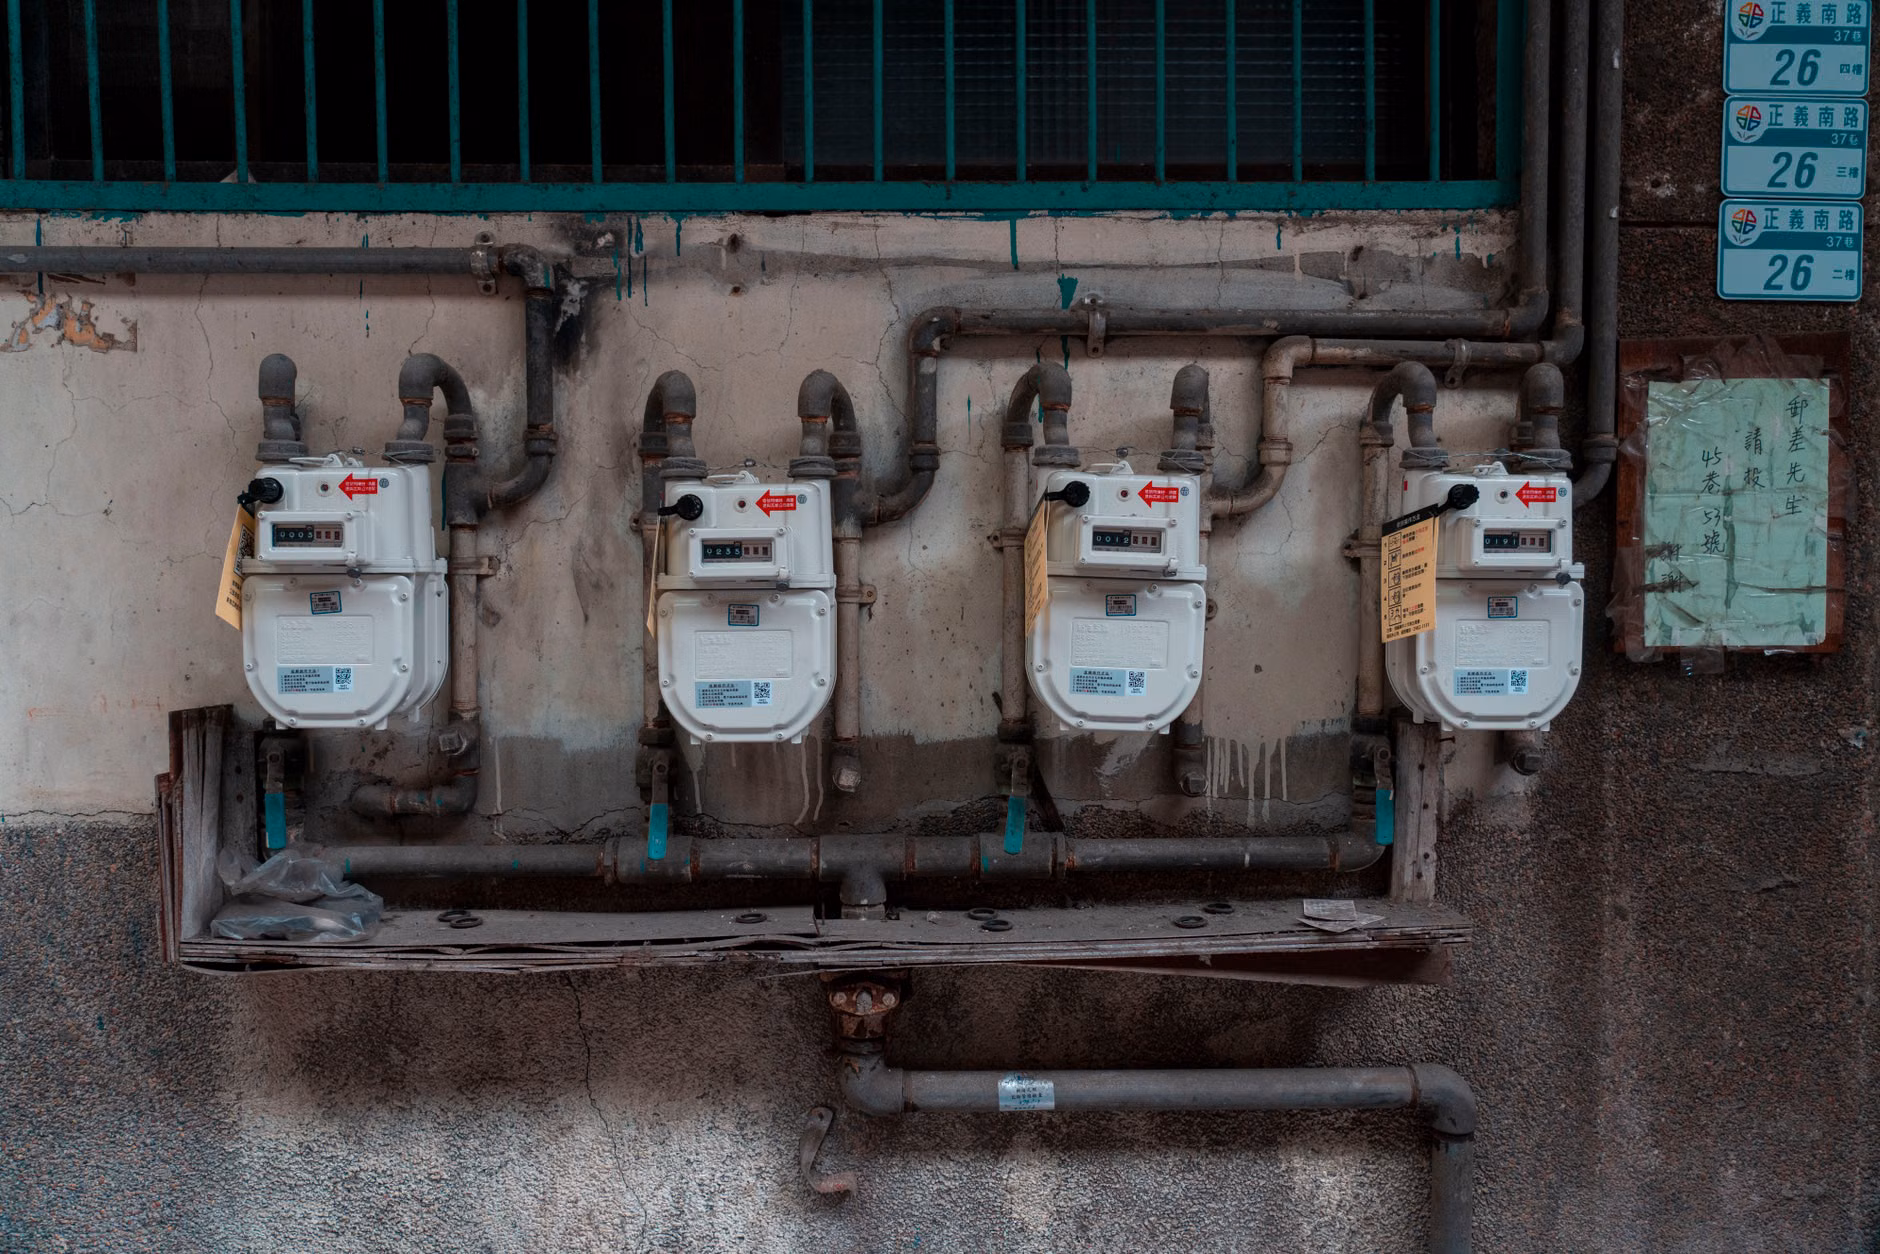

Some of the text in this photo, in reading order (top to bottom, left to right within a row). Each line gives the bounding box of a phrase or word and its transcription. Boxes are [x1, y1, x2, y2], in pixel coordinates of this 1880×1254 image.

[1769, 1, 1862, 25] 正義南路
[1833, 30, 1862, 42] 37巷
[1769, 48, 1863, 87] 26 四樓
[1767, 103, 1859, 128] 正義南路
[1767, 151, 1819, 189] 26
[1763, 207, 1854, 231] 正義南路
[1826, 236, 1854, 248] 37巷
[1763, 254, 1814, 292] 26
[1743, 427, 1765, 489] 請投
[1785, 395, 1809, 516] 郵差先生
